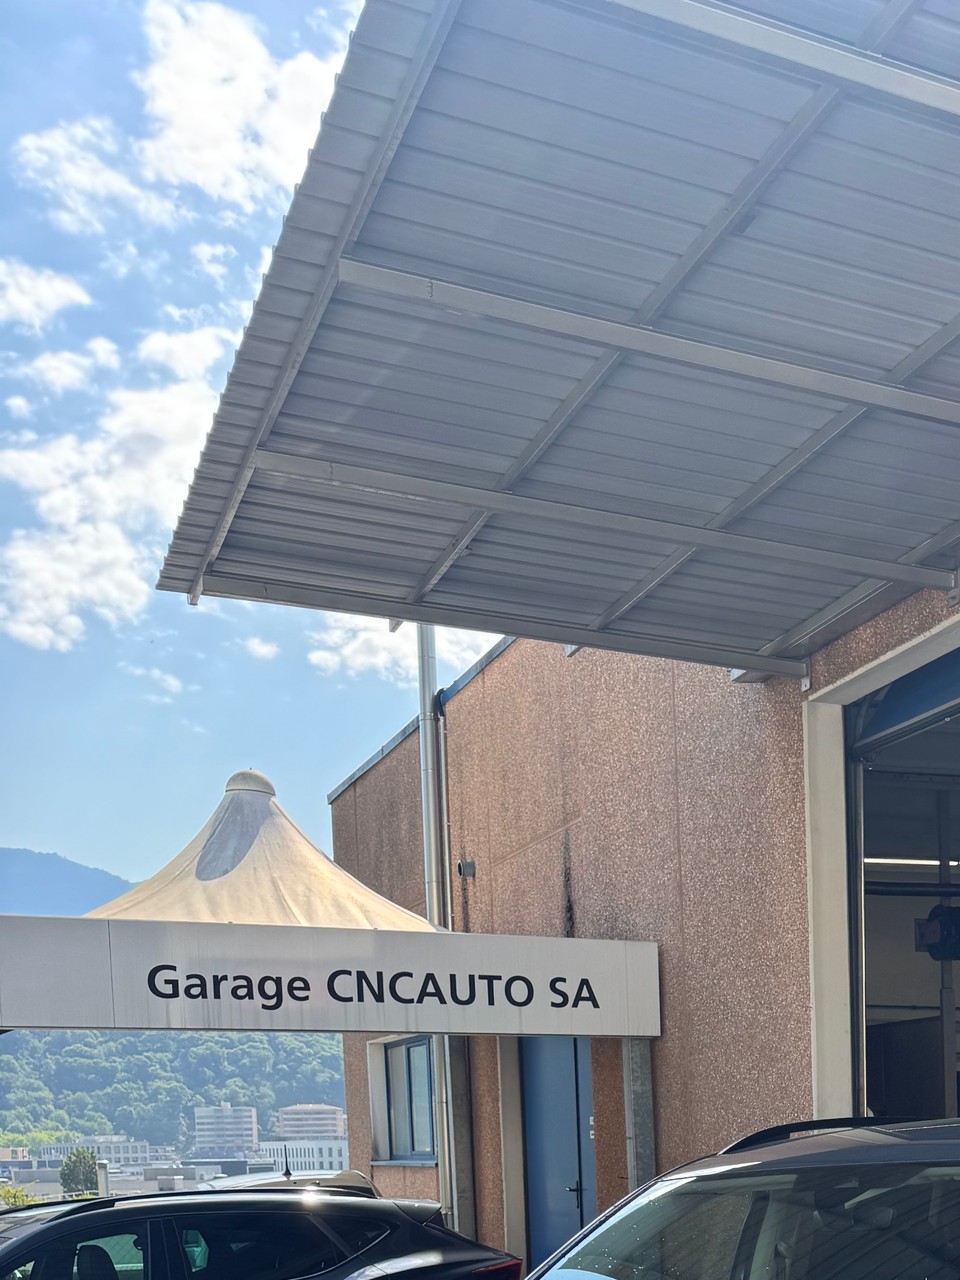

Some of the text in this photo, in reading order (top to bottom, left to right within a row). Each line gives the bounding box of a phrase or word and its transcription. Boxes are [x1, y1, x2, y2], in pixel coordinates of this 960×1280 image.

[147, 964, 600, 1011] Garage CNCAUTO SA
